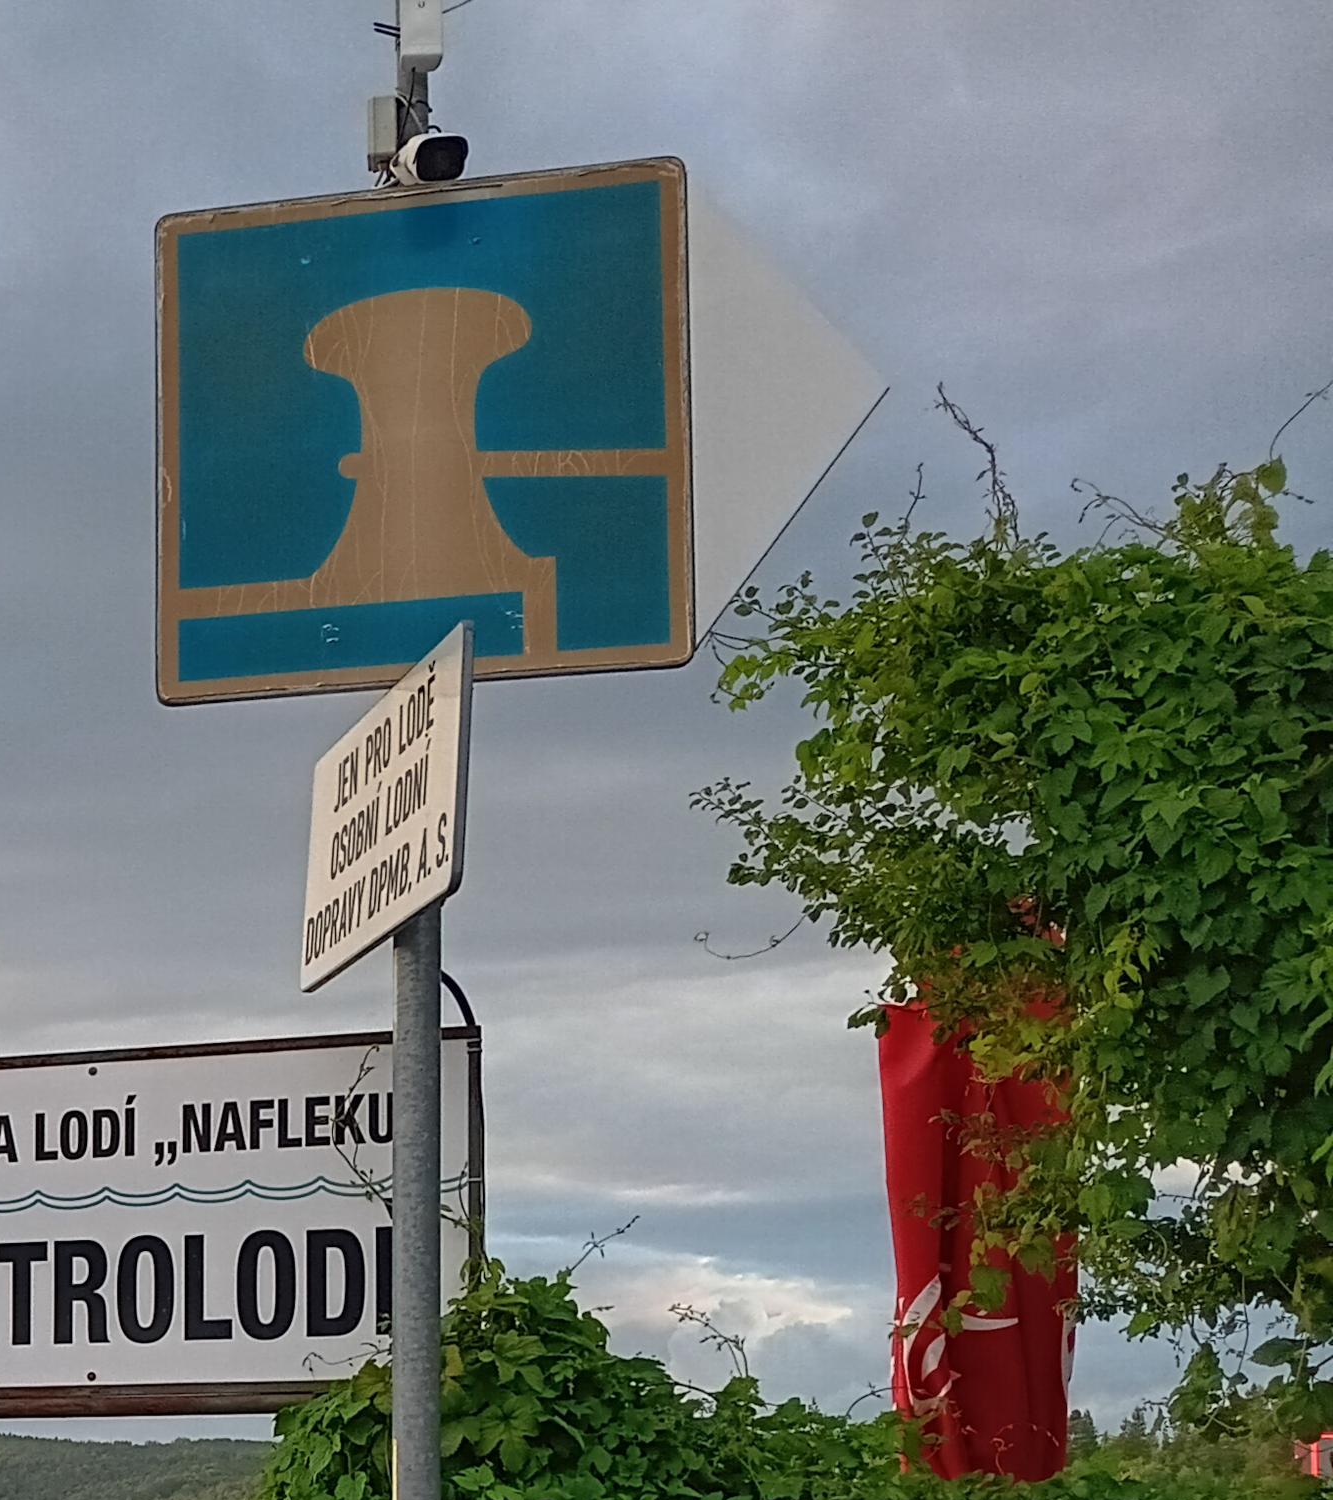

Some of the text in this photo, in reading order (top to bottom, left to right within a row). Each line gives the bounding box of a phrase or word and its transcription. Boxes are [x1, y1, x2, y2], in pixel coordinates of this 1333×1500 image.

[330, 738, 432, 880] OSOBNÍ LODNÍ
[334, 660, 436, 814] JEN PRO LODĚ
[305, 876, 366, 966] DOPRAVY
[417, 827, 432, 882] A.
[436, 812, 450, 869] S.
[34, 1094, 137, 1162] LODÍ
